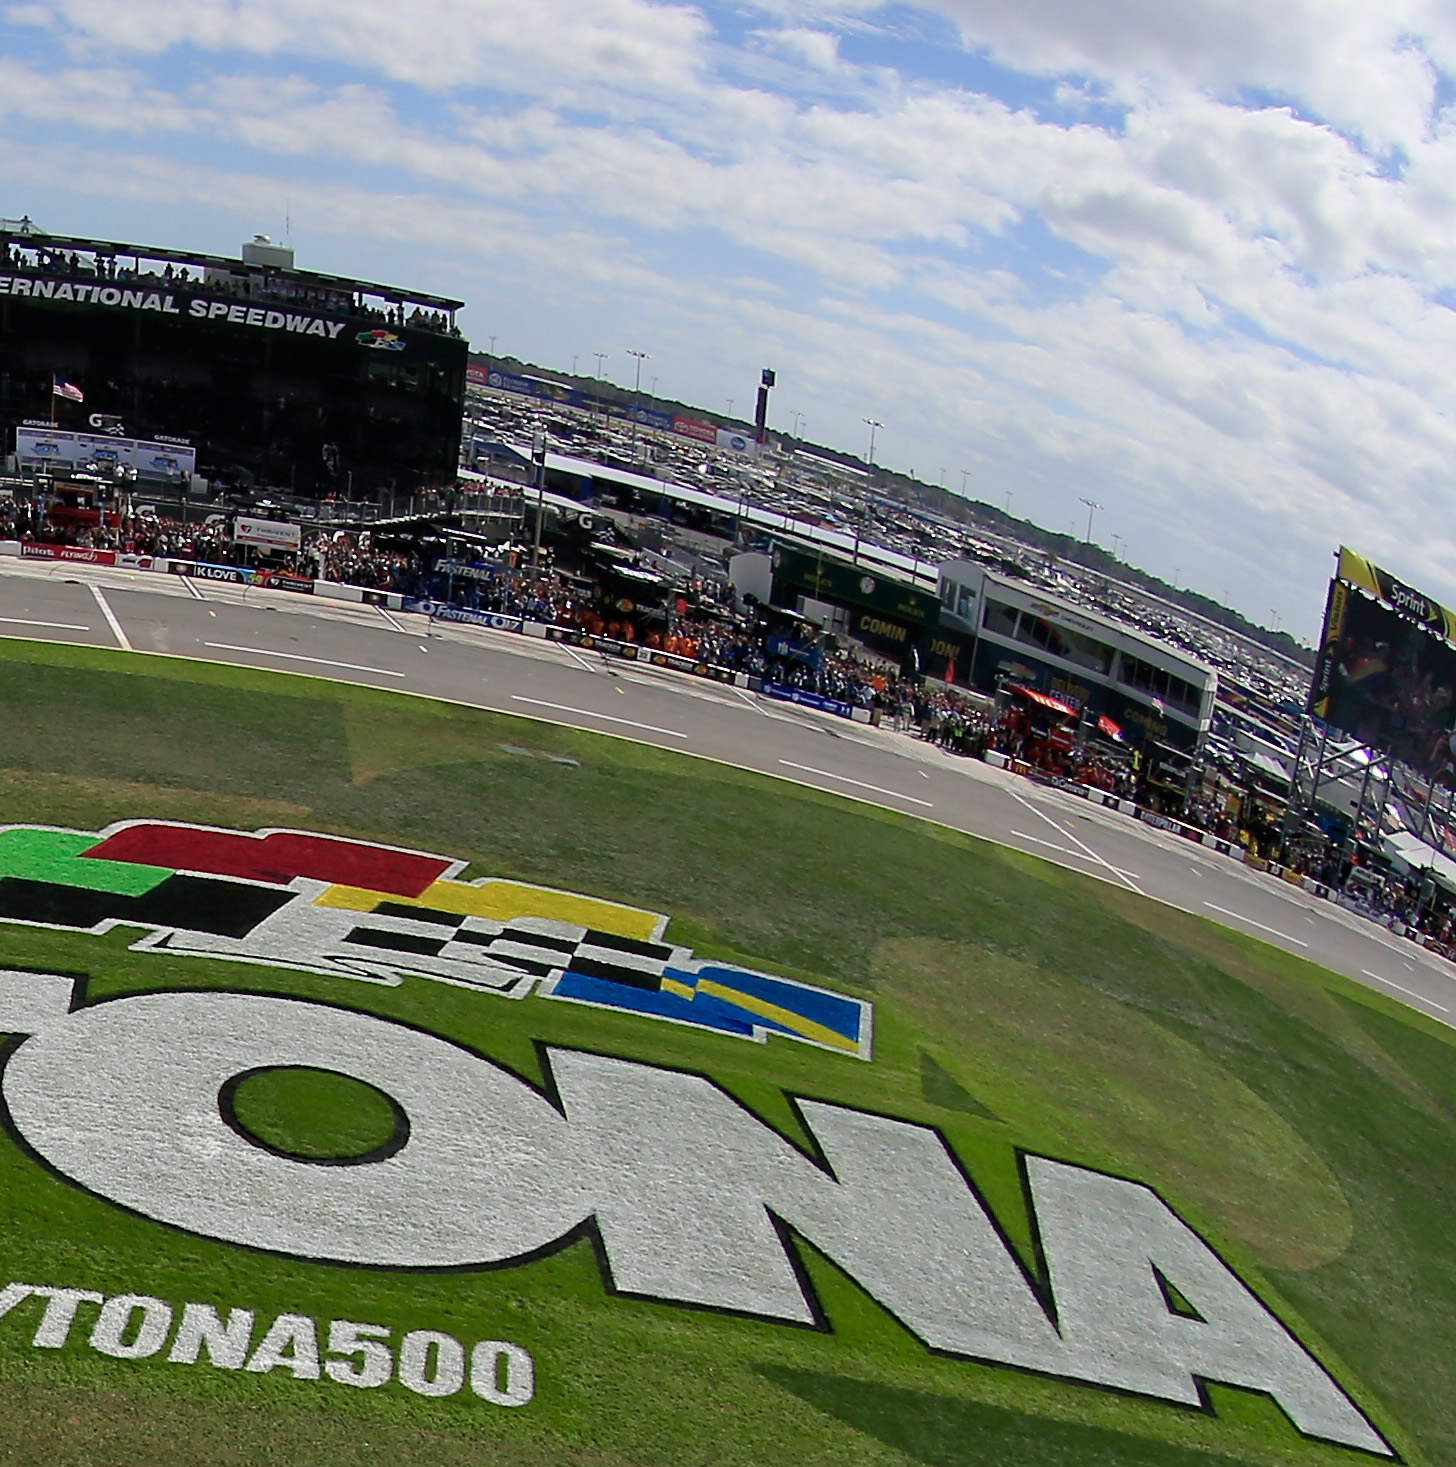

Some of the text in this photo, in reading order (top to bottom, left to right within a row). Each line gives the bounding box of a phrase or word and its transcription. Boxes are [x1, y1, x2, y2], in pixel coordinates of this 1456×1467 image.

[188, 299, 345, 339] SPEEDWAY
[579, 514, 593, 529] G
[197, 566, 237, 581] K LOVE
[435, 558, 491, 581] FASTENAL
[1391, 584, 1426, 617] Sprint
[437, 604, 488, 626] FASTENAL
